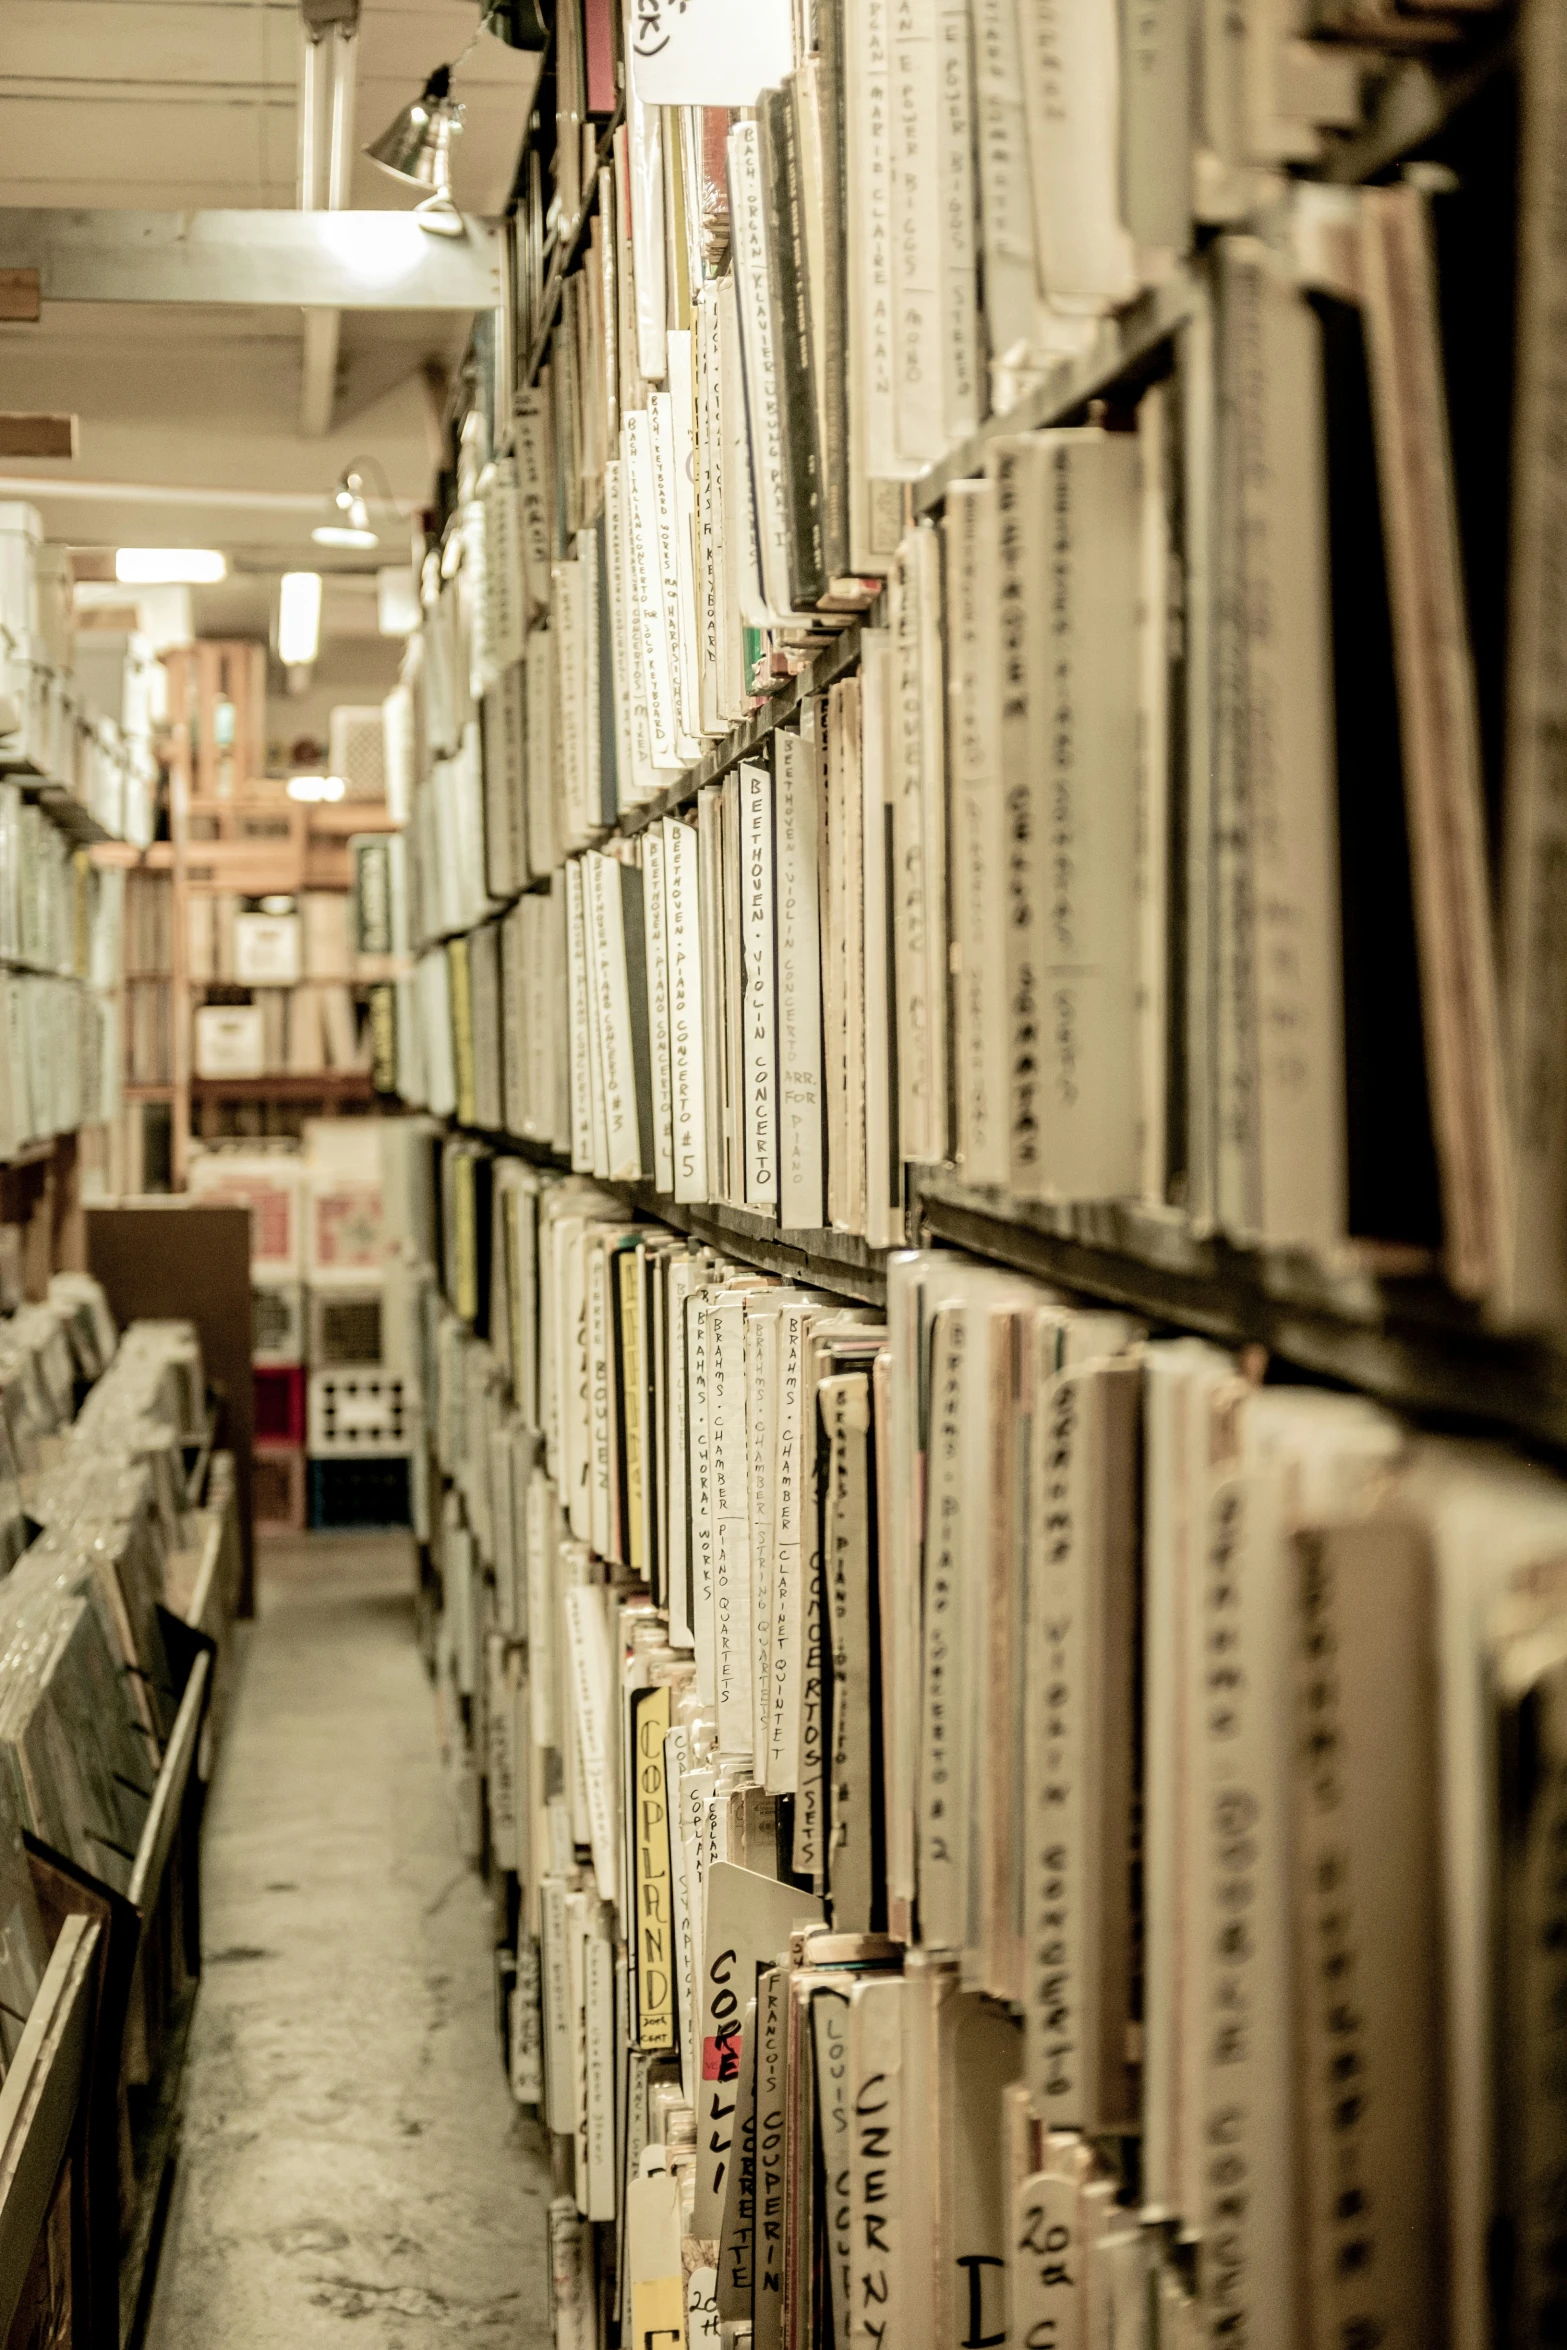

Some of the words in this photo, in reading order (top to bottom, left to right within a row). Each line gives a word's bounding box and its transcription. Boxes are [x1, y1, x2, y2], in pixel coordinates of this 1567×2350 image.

[743, 127, 757, 178] BACH
[868, 85, 885, 175] MARIE
[747, 195, 762, 258] ORGAN
[870, 186, 888, 286] CLAIRE
[873, 299, 890, 395] ALAIN
[627, 417, 638, 457] BACH
[651, 395, 660, 436] BACH
[631, 469, 642, 529] ITALIAN
[654, 444, 668, 516] KEYBOARD
[635, 533, 649, 603] CONCERTO
[660, 524, 672, 570] WORKS
[644, 623, 654, 654] SOLO
[648, 659, 666, 740] KEYBOARD
[783, 739, 796, 852] BEETHOVEN
[649, 843, 661, 941] BEETHOVEN
[672, 826, 685, 935] BEETHOVEN
[750, 778, 765, 923] BEETHOVEN
[594, 857, 608, 949] BEETHOVEN
[783, 872, 796, 948] VIOLIN
[600, 960, 611, 1010] PIANO
[655, 955, 665, 1013] PIANO
[676, 951, 687, 1011] PIANO
[752, 950, 766, 1040] VIOLIN
[783, 958, 797, 1062] CONCERTO
[603, 1014, 618, 1091] CONCERTO
[656, 1019, 671, 1113] CONCERTO
[676, 1020, 692, 1123] CONCERTO
[613, 1115, 624, 1133] 3
[681, 1131, 692, 1147] #
[754, 1056, 772, 1185] CONCERTO
[784, 1090, 817, 1104] FOR
[682, 1154, 696, 1178] 5
[791, 1114, 804, 1184] PIANO
[696, 1311, 706, 1404] BRAHMS
[714, 1318, 725, 1397] BRAHMS
[755, 1323, 766, 1400] BRAHMS
[786, 1318, 798, 1405] BRAHMS
[698, 1434, 708, 1516] CHORAL
[714, 1417, 728, 1509] CHAMBER
[754, 1421, 766, 1515] CHAMBER
[781, 1429, 793, 1530] CHAMBER
[699, 1531, 712, 1600] WORKS
[718, 1524, 728, 1587] PIANO
[756, 1531, 769, 1610] STRING
[835, 1537, 849, 1618] PIANO
[778, 1550, 790, 1650] CLARINET
[719, 1597, 734, 1702] QUARTETS
[758, 1621, 769, 1730] QUARTETS
[771, 1659, 787, 1760] QUINTET
[640, 1719, 668, 2011] COPLAND
[930, 1834, 951, 1864] 2
[1039, 1845, 1074, 2096] CONCERTO
[709, 1948, 742, 2195] CORELLI
[765, 1973, 781, 2093] FRANCOIS
[827, 2019, 848, 2133] LOUIS
[762, 2110, 784, 2292] COUPERIN
[856, 2072, 892, 2350] CZERNY
